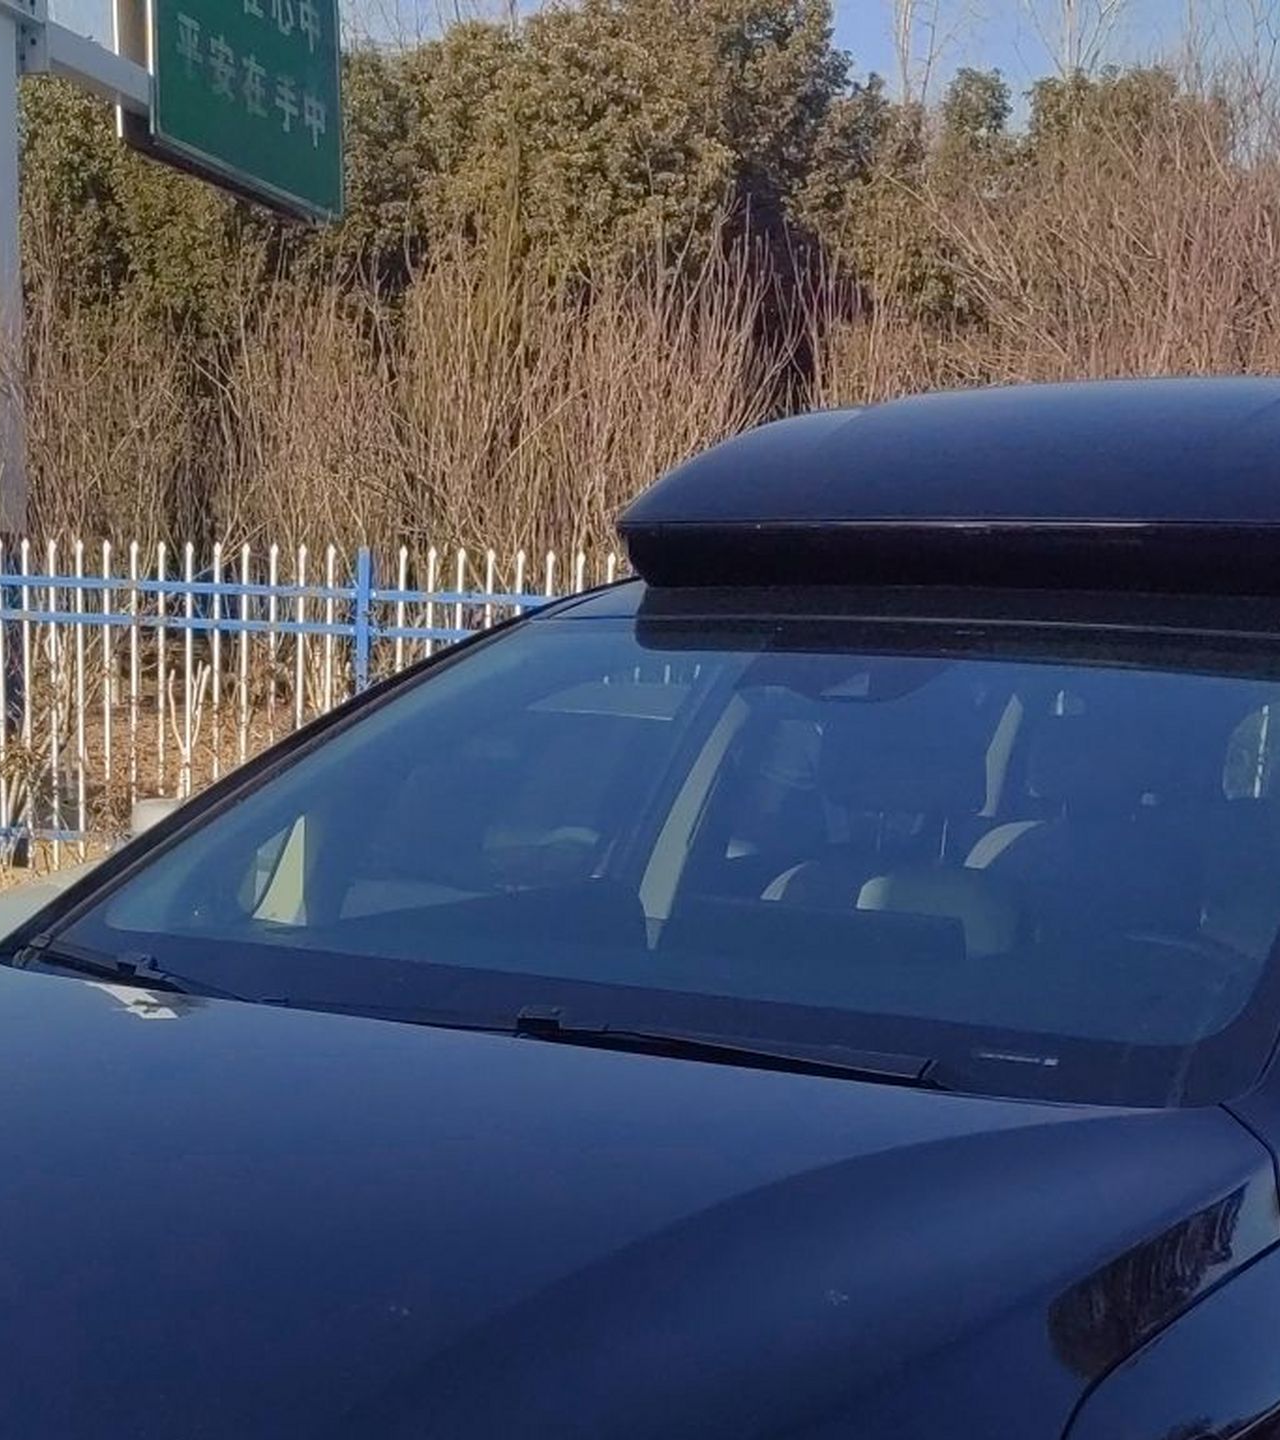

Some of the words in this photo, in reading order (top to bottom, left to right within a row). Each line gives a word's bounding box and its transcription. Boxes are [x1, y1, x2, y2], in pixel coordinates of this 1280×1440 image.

[176, 11, 327, 150] 平安在手中
